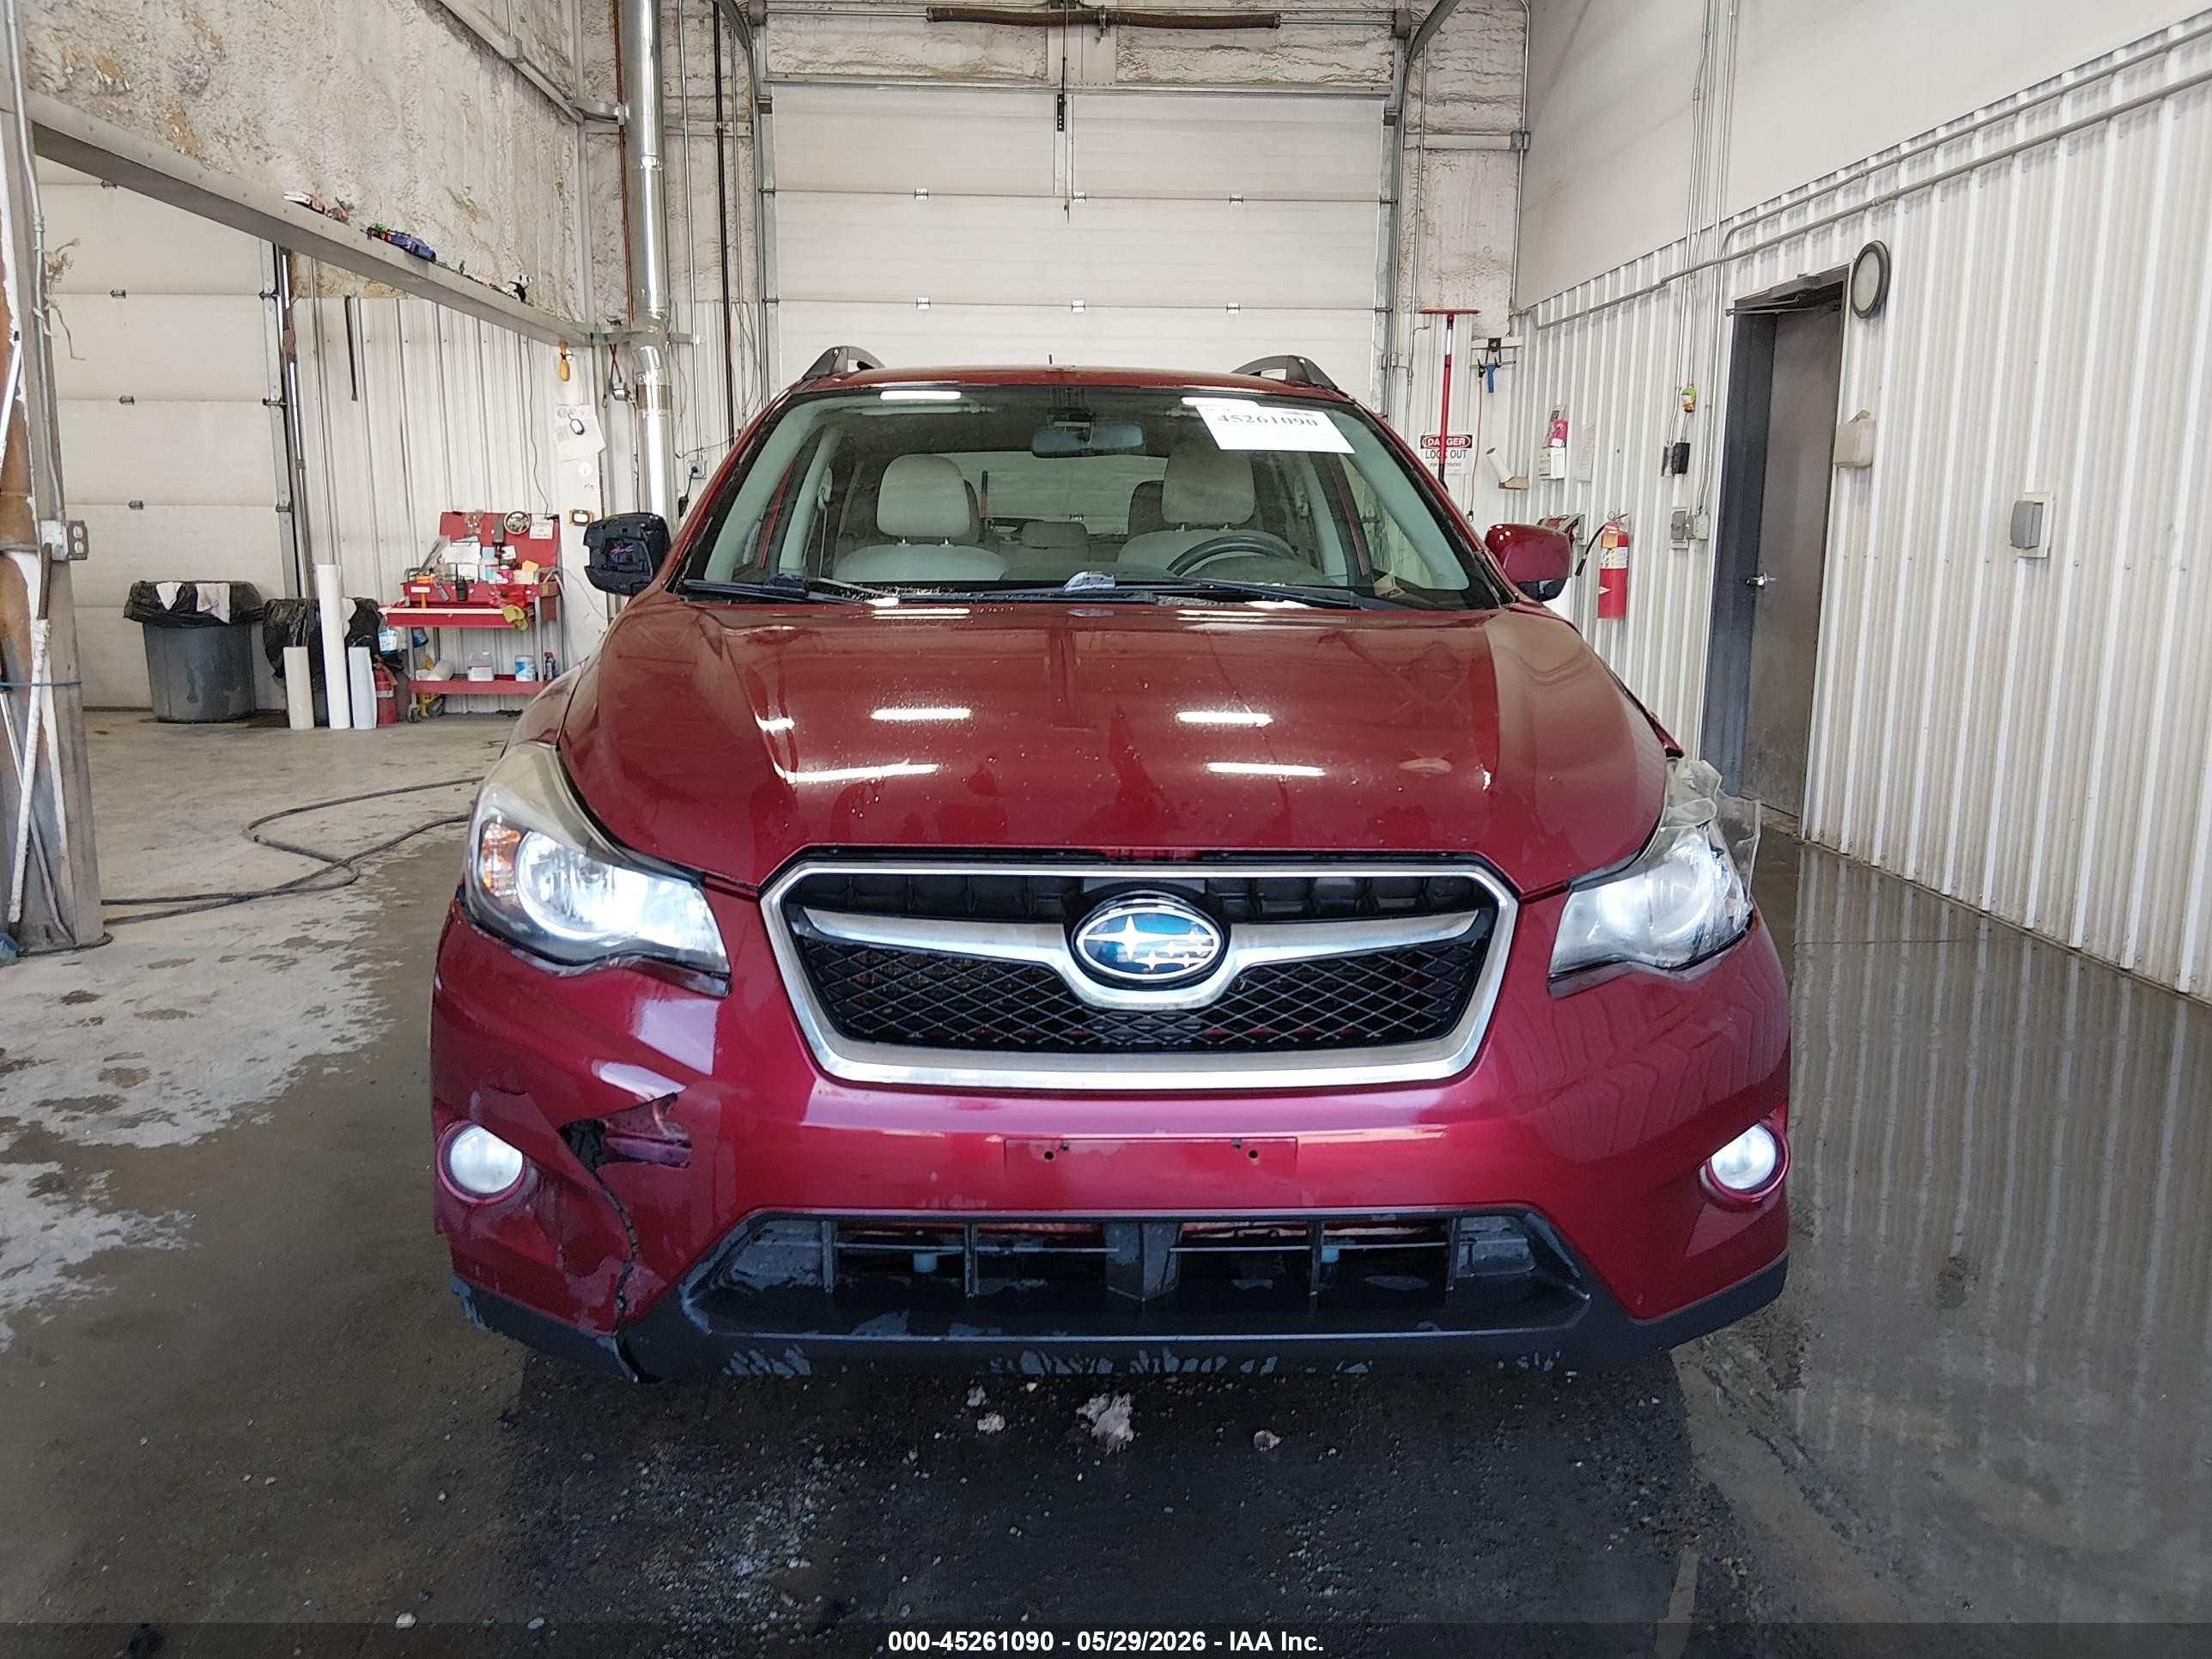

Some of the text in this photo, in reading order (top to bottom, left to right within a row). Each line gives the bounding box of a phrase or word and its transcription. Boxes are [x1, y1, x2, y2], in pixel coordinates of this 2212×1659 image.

[1218, 414, 1319, 426] 45261090
[1427, 437, 1466, 447] DAGER
[1450, 449, 1468, 459] OUT
